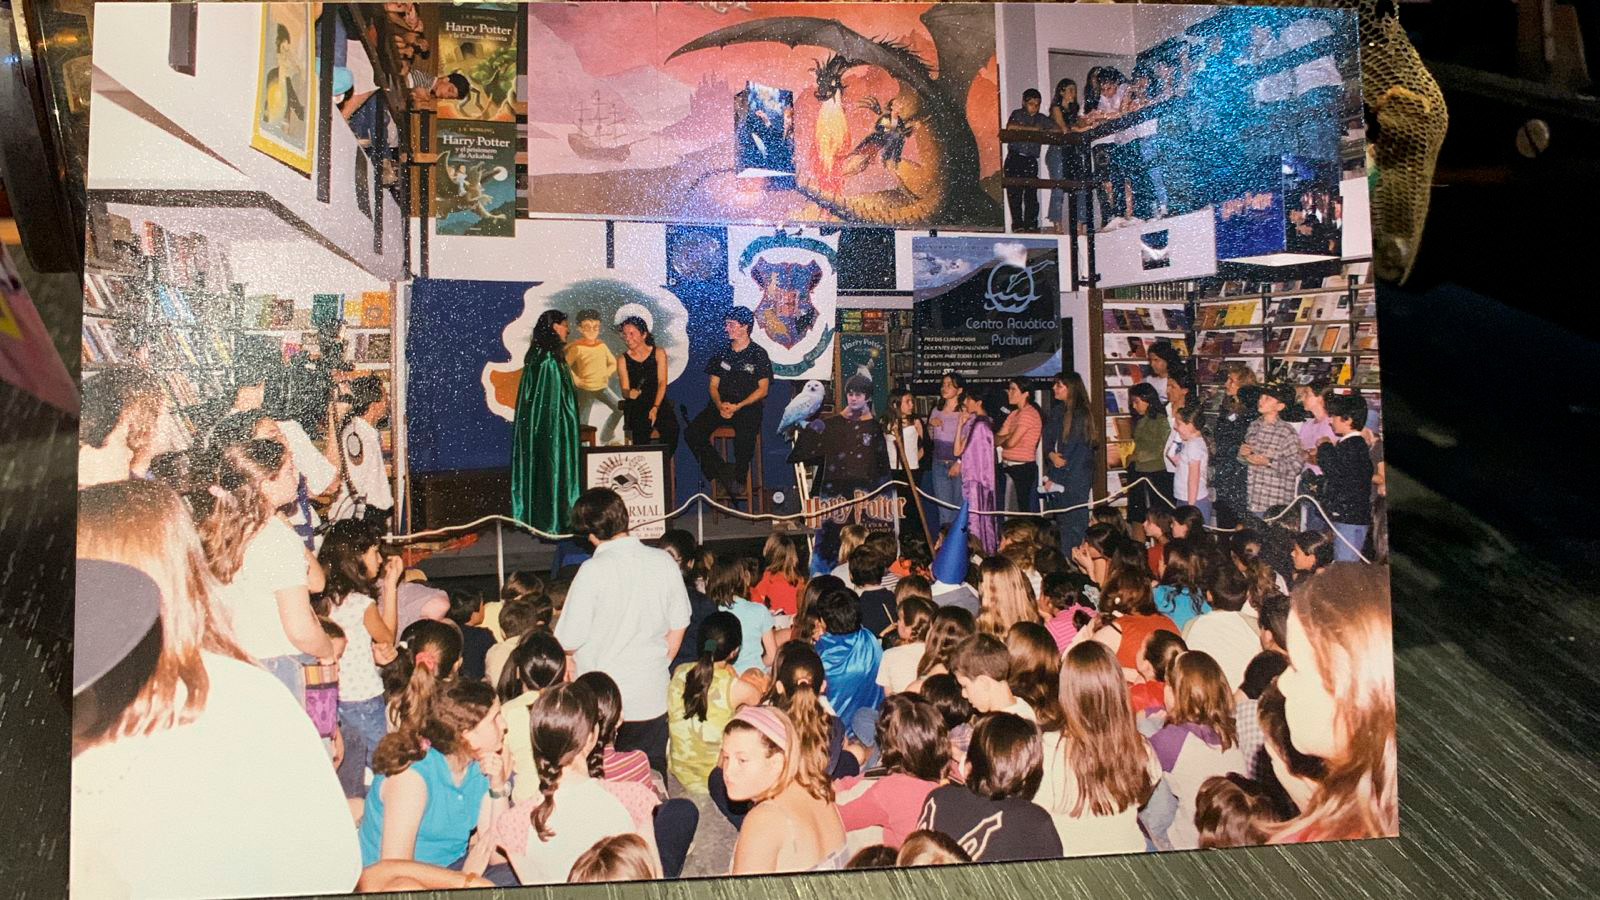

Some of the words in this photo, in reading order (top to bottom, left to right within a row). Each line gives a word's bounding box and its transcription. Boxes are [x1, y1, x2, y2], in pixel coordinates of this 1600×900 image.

[446, 22, 477, 35] Harry
[480, 24, 512, 35] Potter
[443, 134, 475, 147] Harry
[477, 136, 511, 147] Potter
[966, 317, 1003, 329] Centro
[1007, 318, 1055, 329] Acuático
[991, 334, 1032, 346] Puchuri
[628, 504, 661, 517] RMAL
